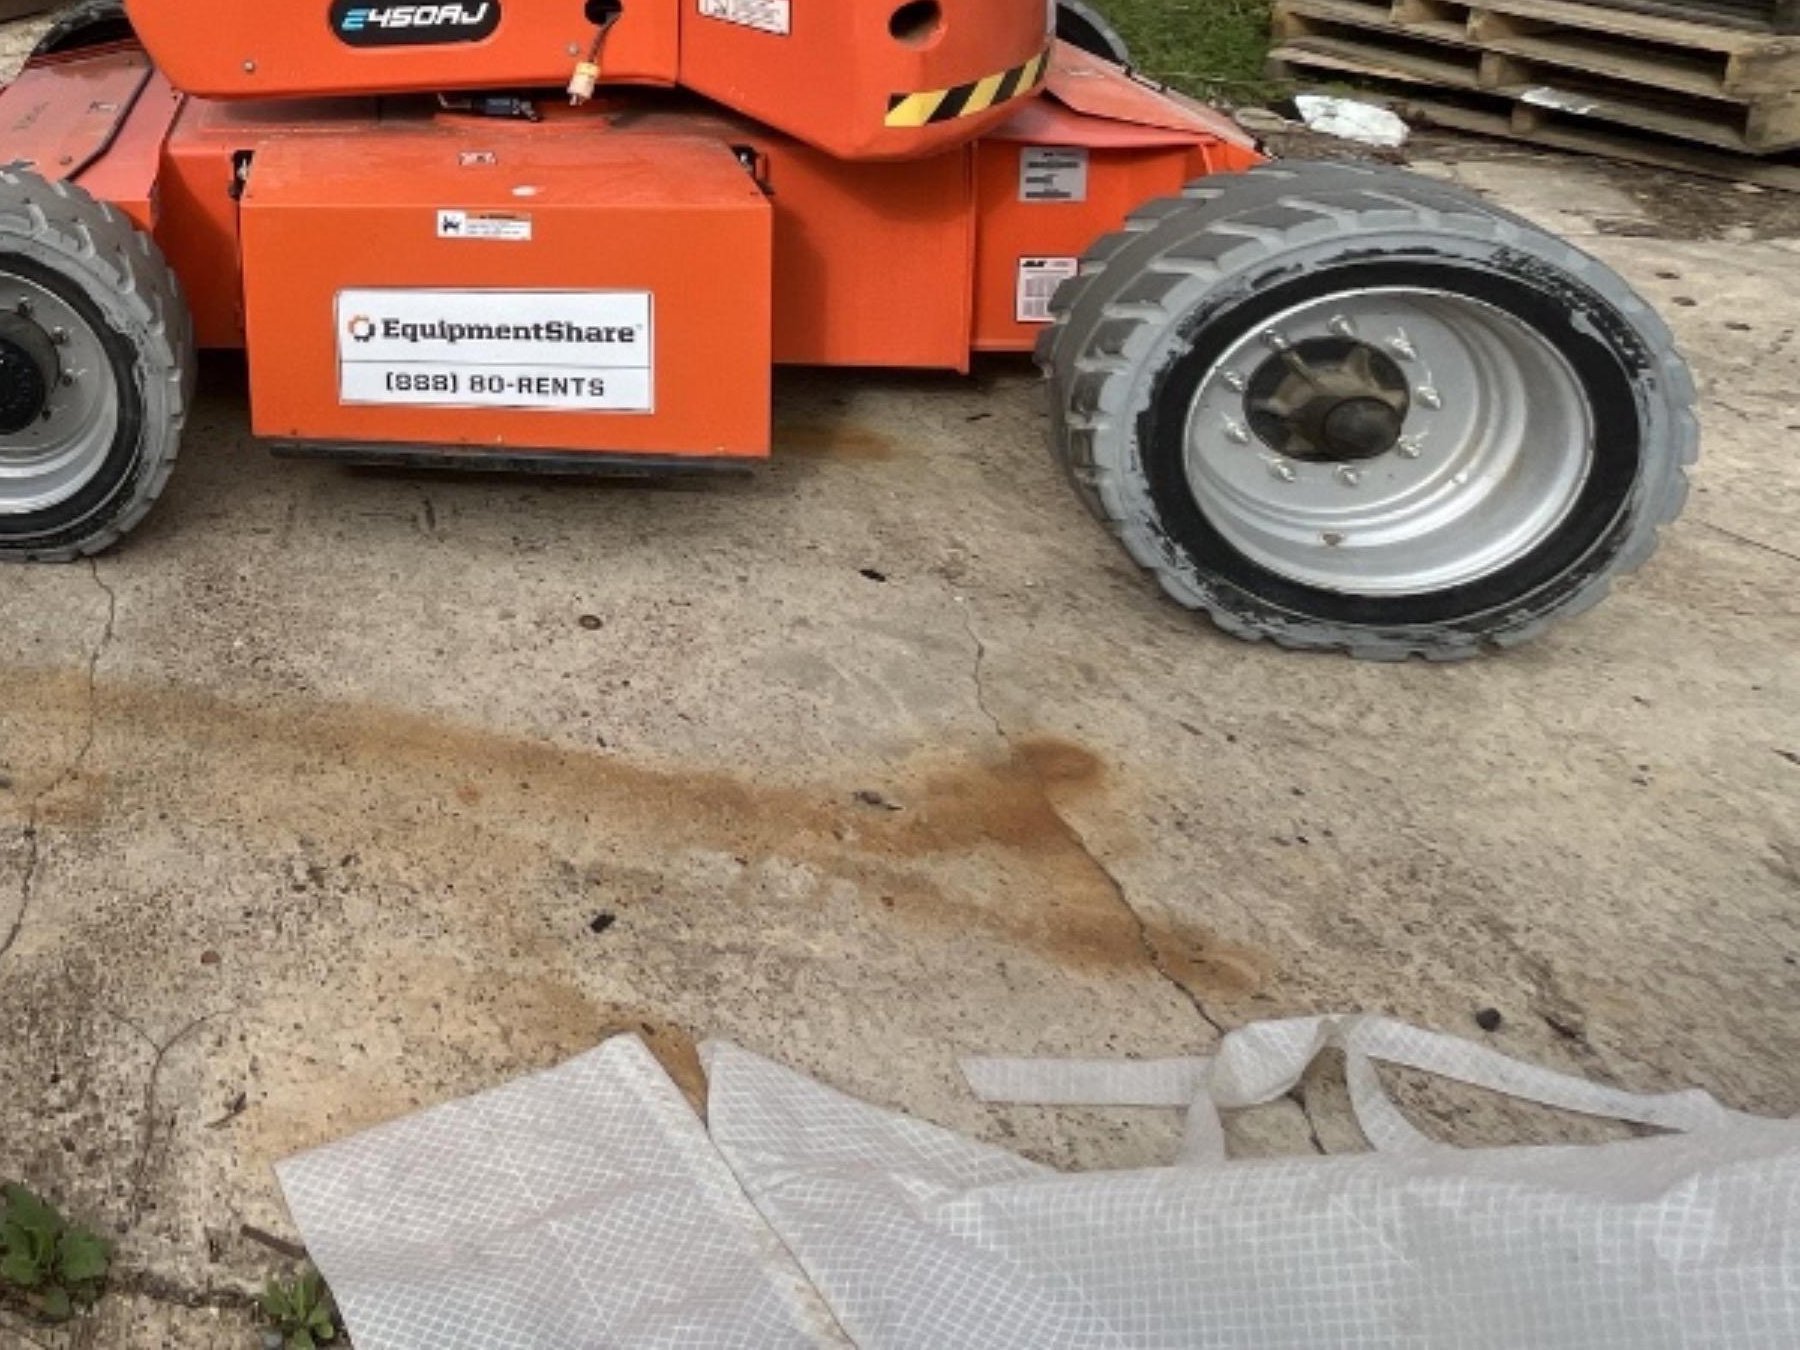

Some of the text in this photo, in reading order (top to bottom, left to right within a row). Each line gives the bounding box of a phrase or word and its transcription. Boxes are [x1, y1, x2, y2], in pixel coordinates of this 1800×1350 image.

[341, 2, 489, 31] E450AJ
[381, 317, 635, 344] EquipmentShare
[385, 371, 606, 397] (888) 80-RENTS
